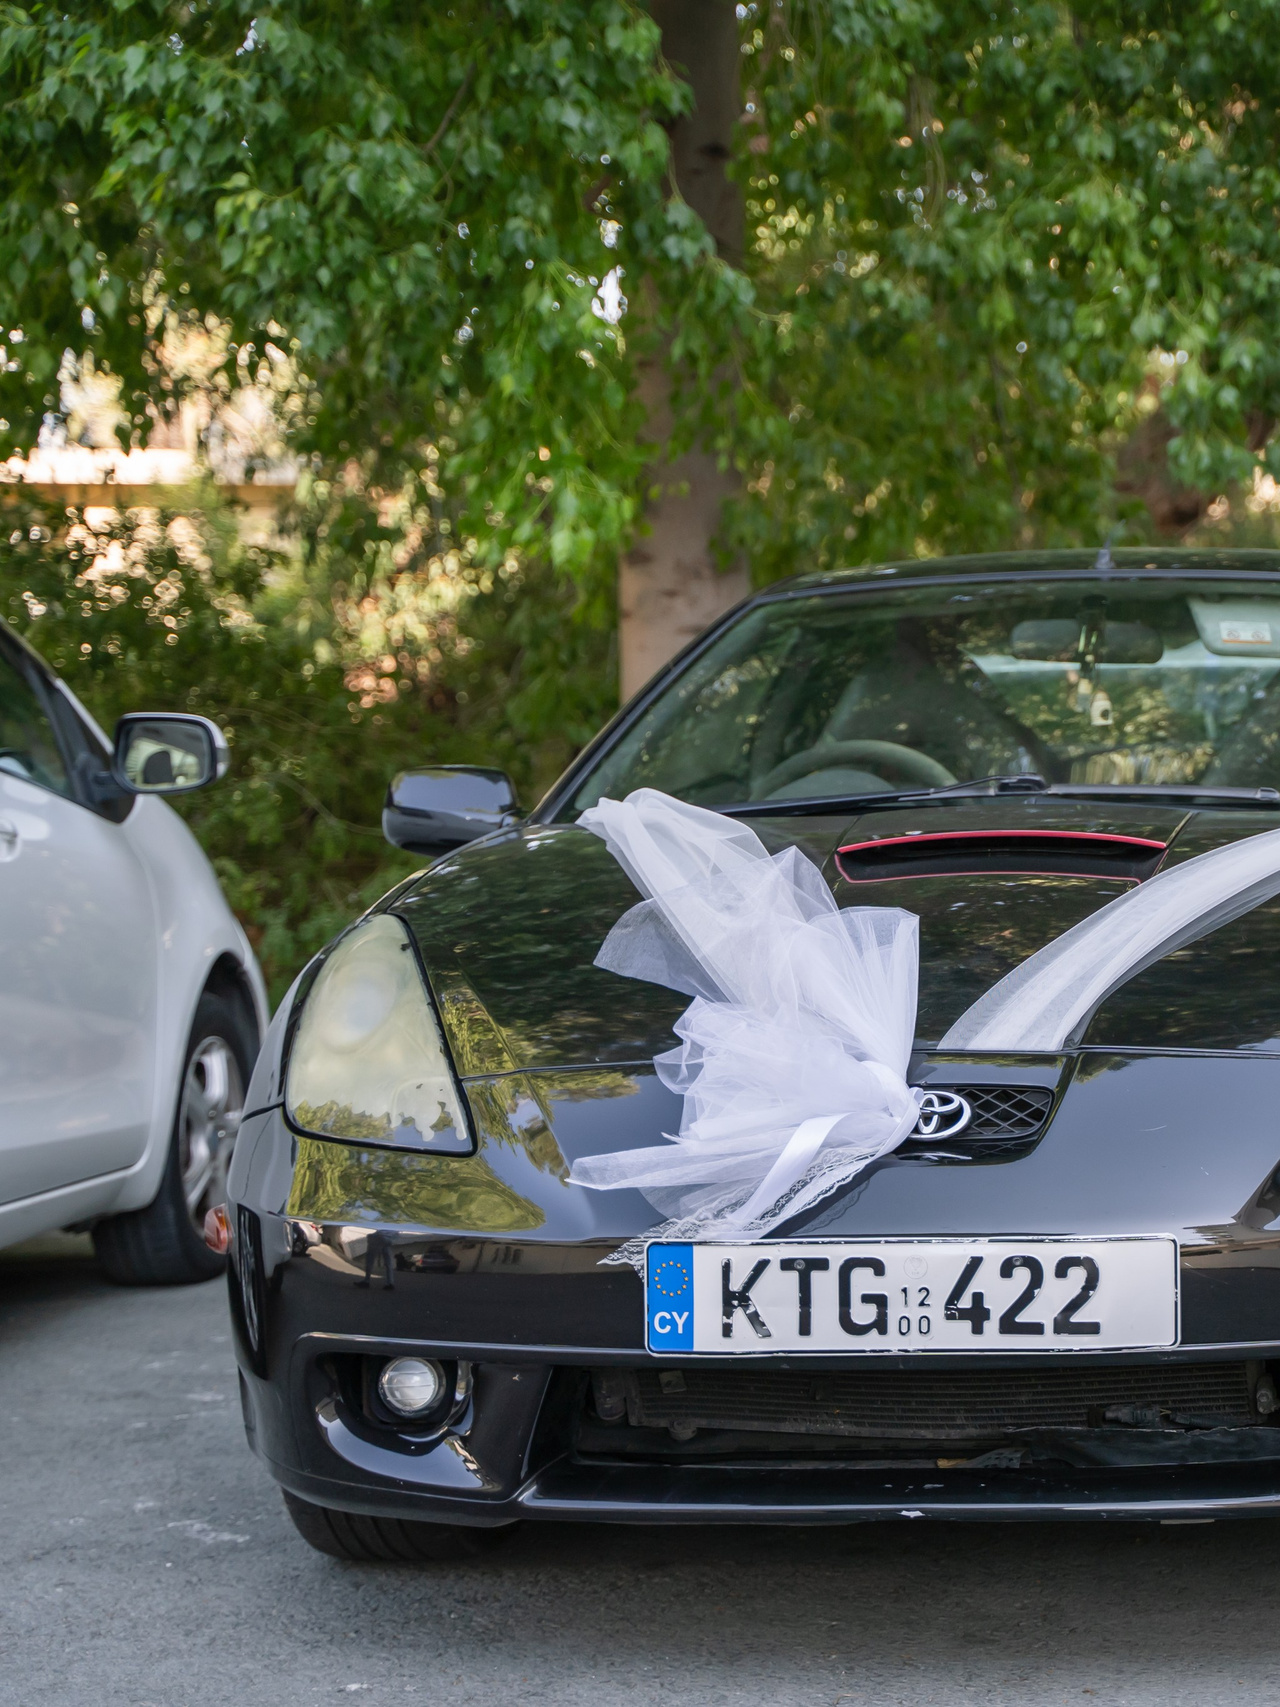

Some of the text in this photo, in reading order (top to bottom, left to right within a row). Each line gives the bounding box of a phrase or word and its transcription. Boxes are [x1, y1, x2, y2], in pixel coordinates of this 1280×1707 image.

[721, 1255, 1100, 1338] KTG 422
[900, 1286, 931, 1307] 12
[653, 1311, 690, 1334] CY
[898, 1315, 931, 1336] 00
